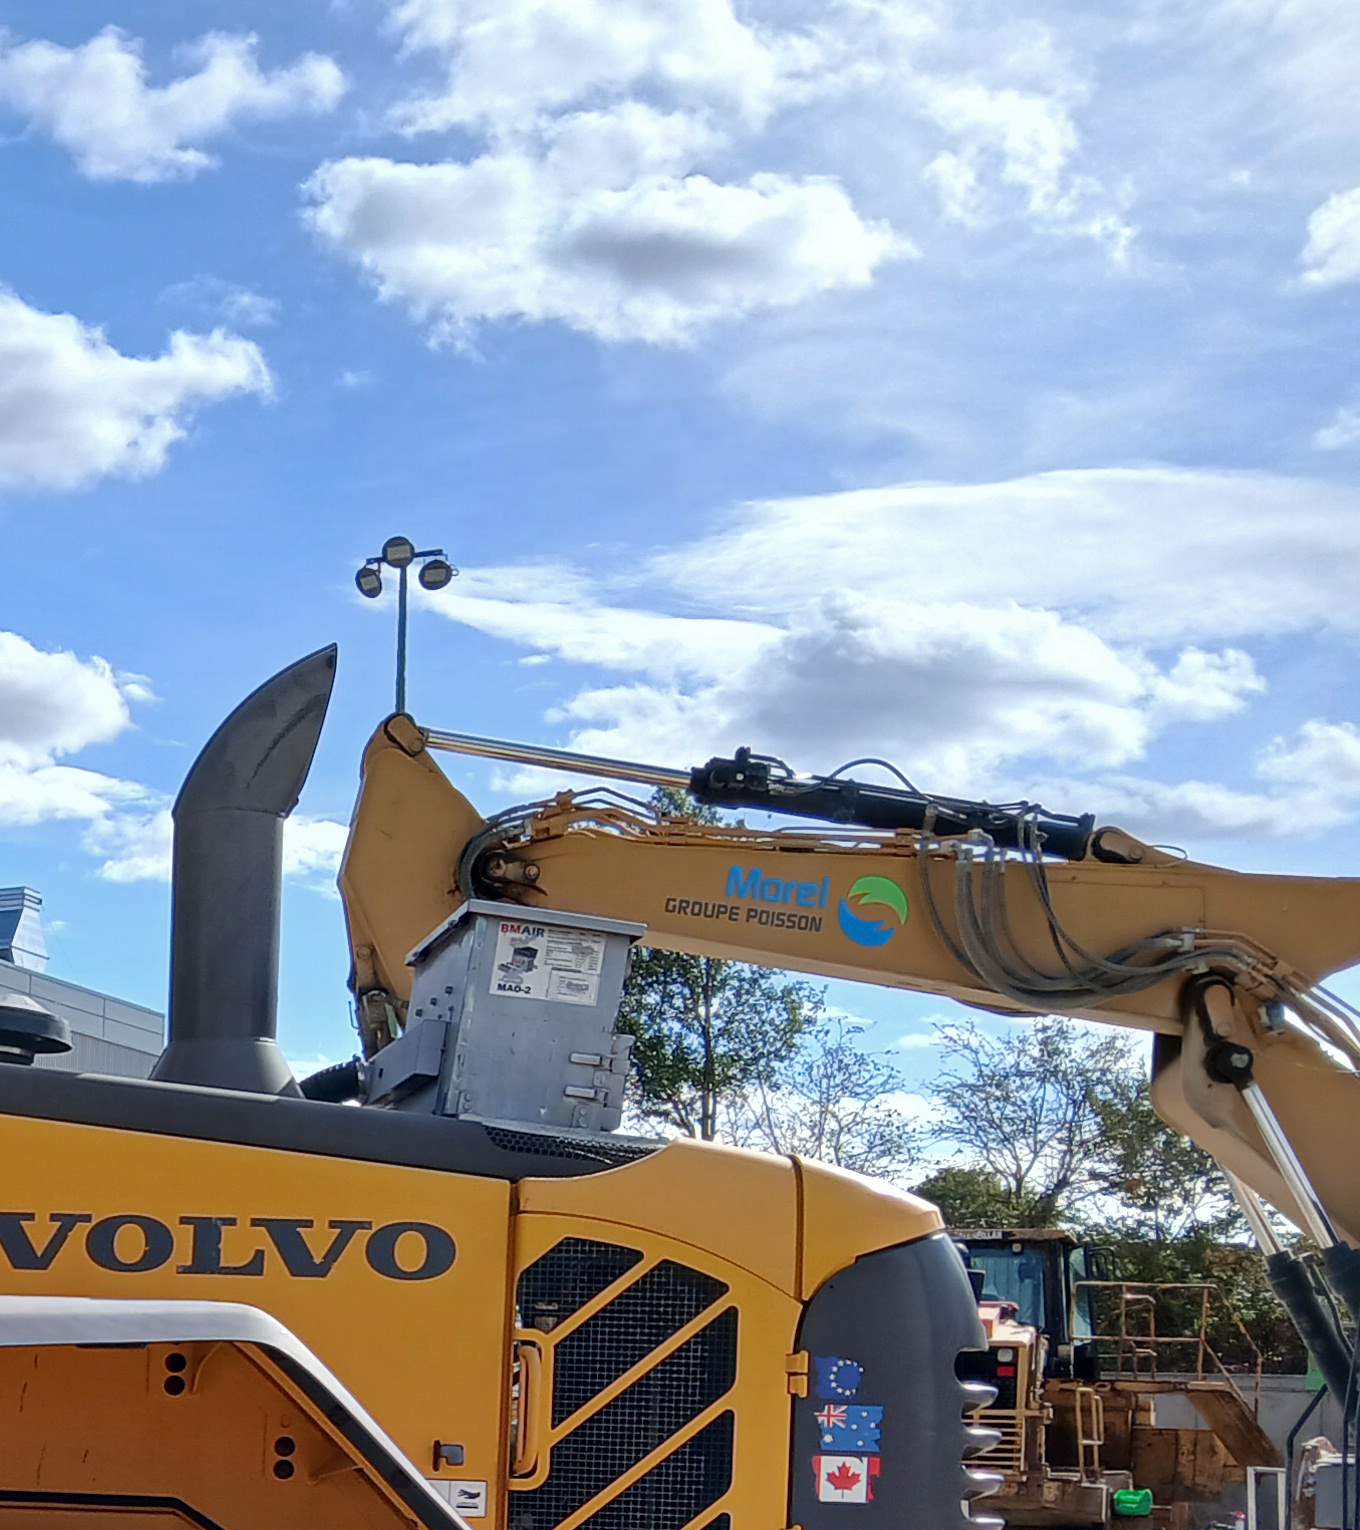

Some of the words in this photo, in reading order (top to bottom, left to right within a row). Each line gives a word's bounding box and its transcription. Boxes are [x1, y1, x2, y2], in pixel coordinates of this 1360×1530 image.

[726, 864, 830, 908] Morel
[501, 923, 545, 938] BMAIR
[664, 898, 740, 921] GROUPE
[746, 907, 822, 932] POISSON
